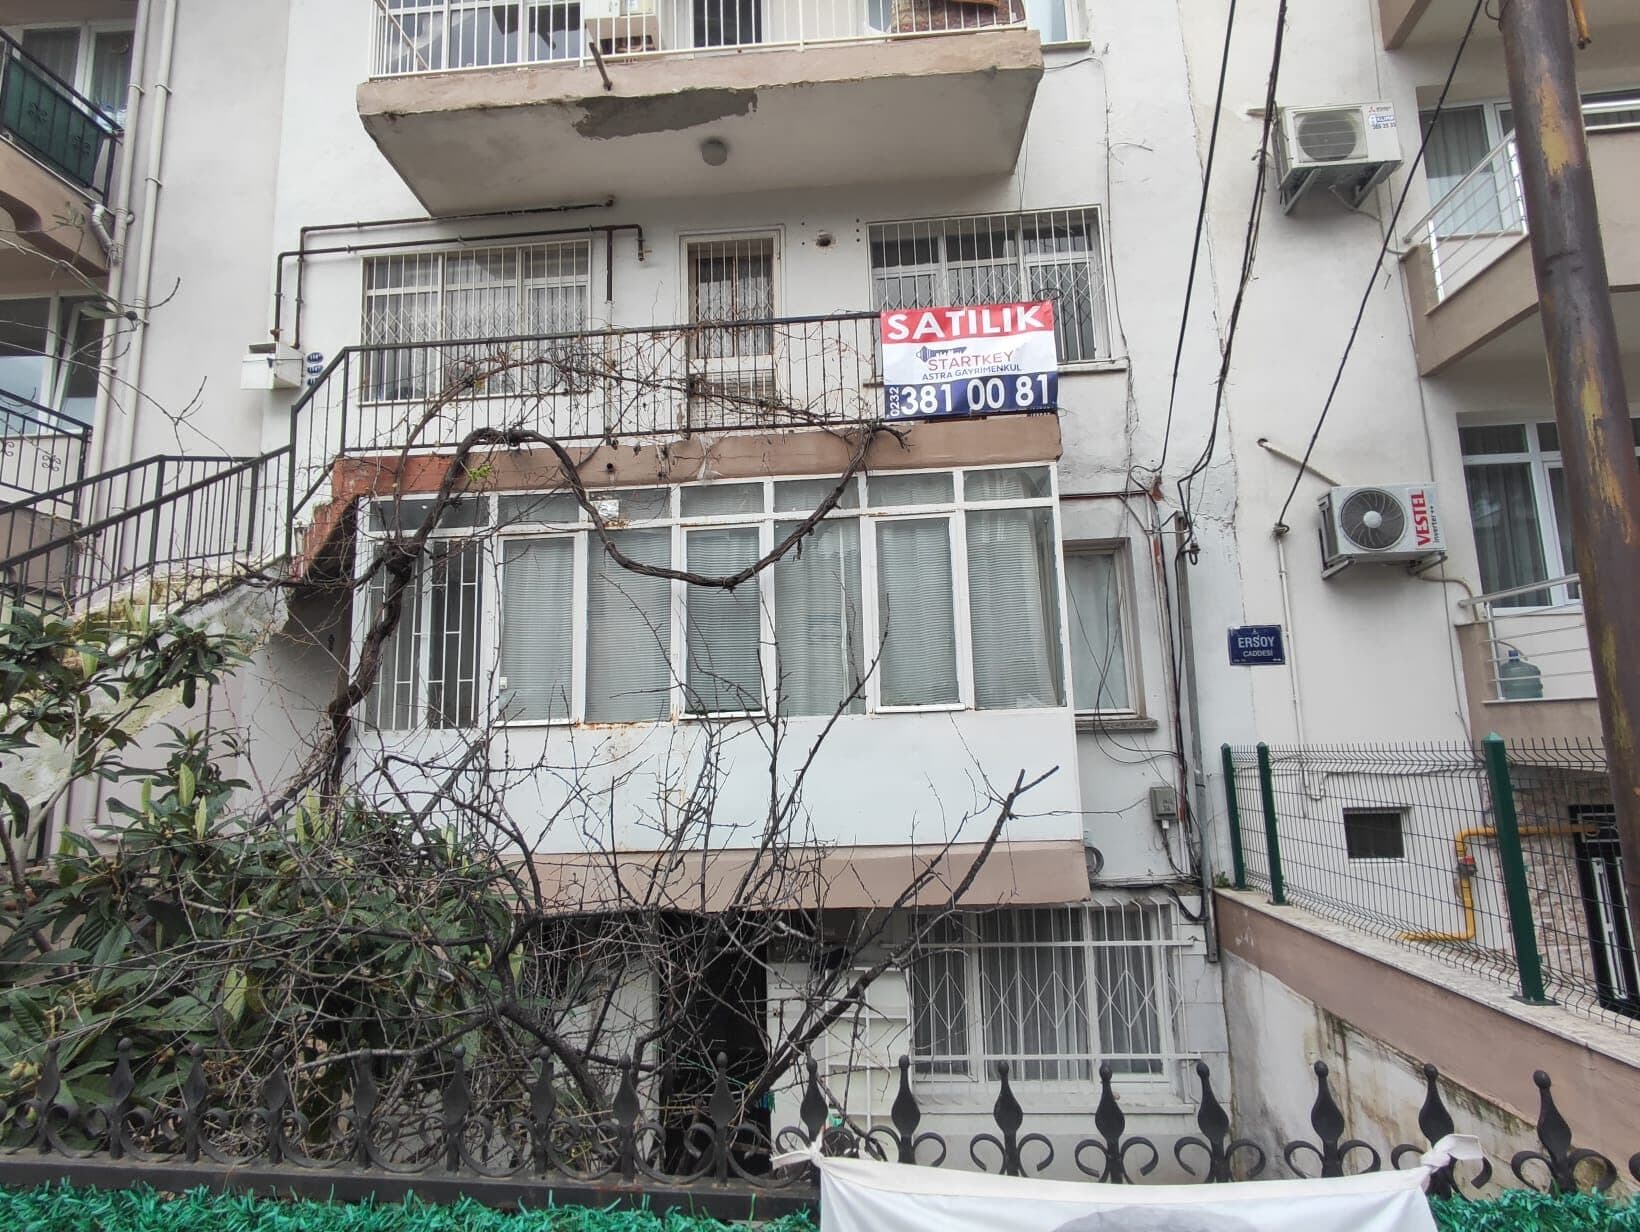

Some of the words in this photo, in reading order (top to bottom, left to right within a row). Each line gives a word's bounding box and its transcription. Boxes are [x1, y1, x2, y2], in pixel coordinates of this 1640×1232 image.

[887, 305, 1044, 340] SATILIK
[928, 350, 1014, 371] STARTKEY
[922, 370, 953, 381] ASTRA
[889, 386, 900, 417] 0232
[901, 383, 953, 416] 381
[966, 377, 1005, 411] 00
[1015, 374, 1049, 407] 81
[1410, 489, 1432, 546] VESTEL
[1238, 636, 1274, 648] ERSOY
